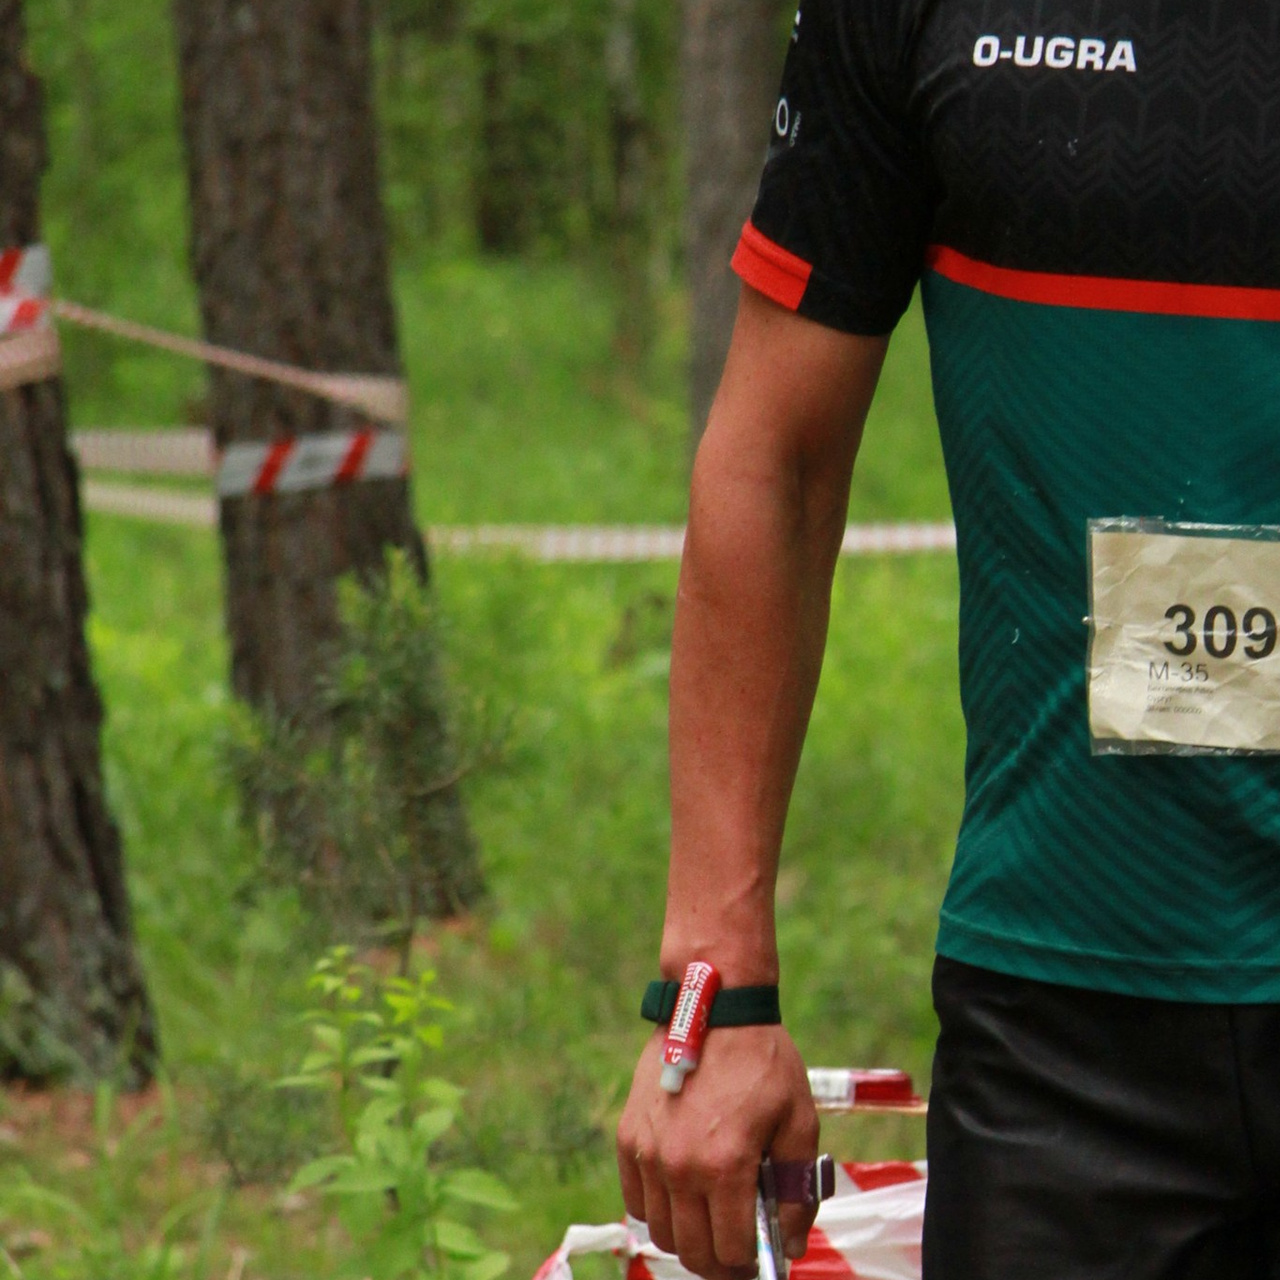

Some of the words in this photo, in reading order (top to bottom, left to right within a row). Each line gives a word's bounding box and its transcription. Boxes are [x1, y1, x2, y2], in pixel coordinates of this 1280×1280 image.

[972, 35, 1137, 73] O-UGRA
[1163, 603, 1278, 660] 309
[1148, 661, 1209, 682] M-35
